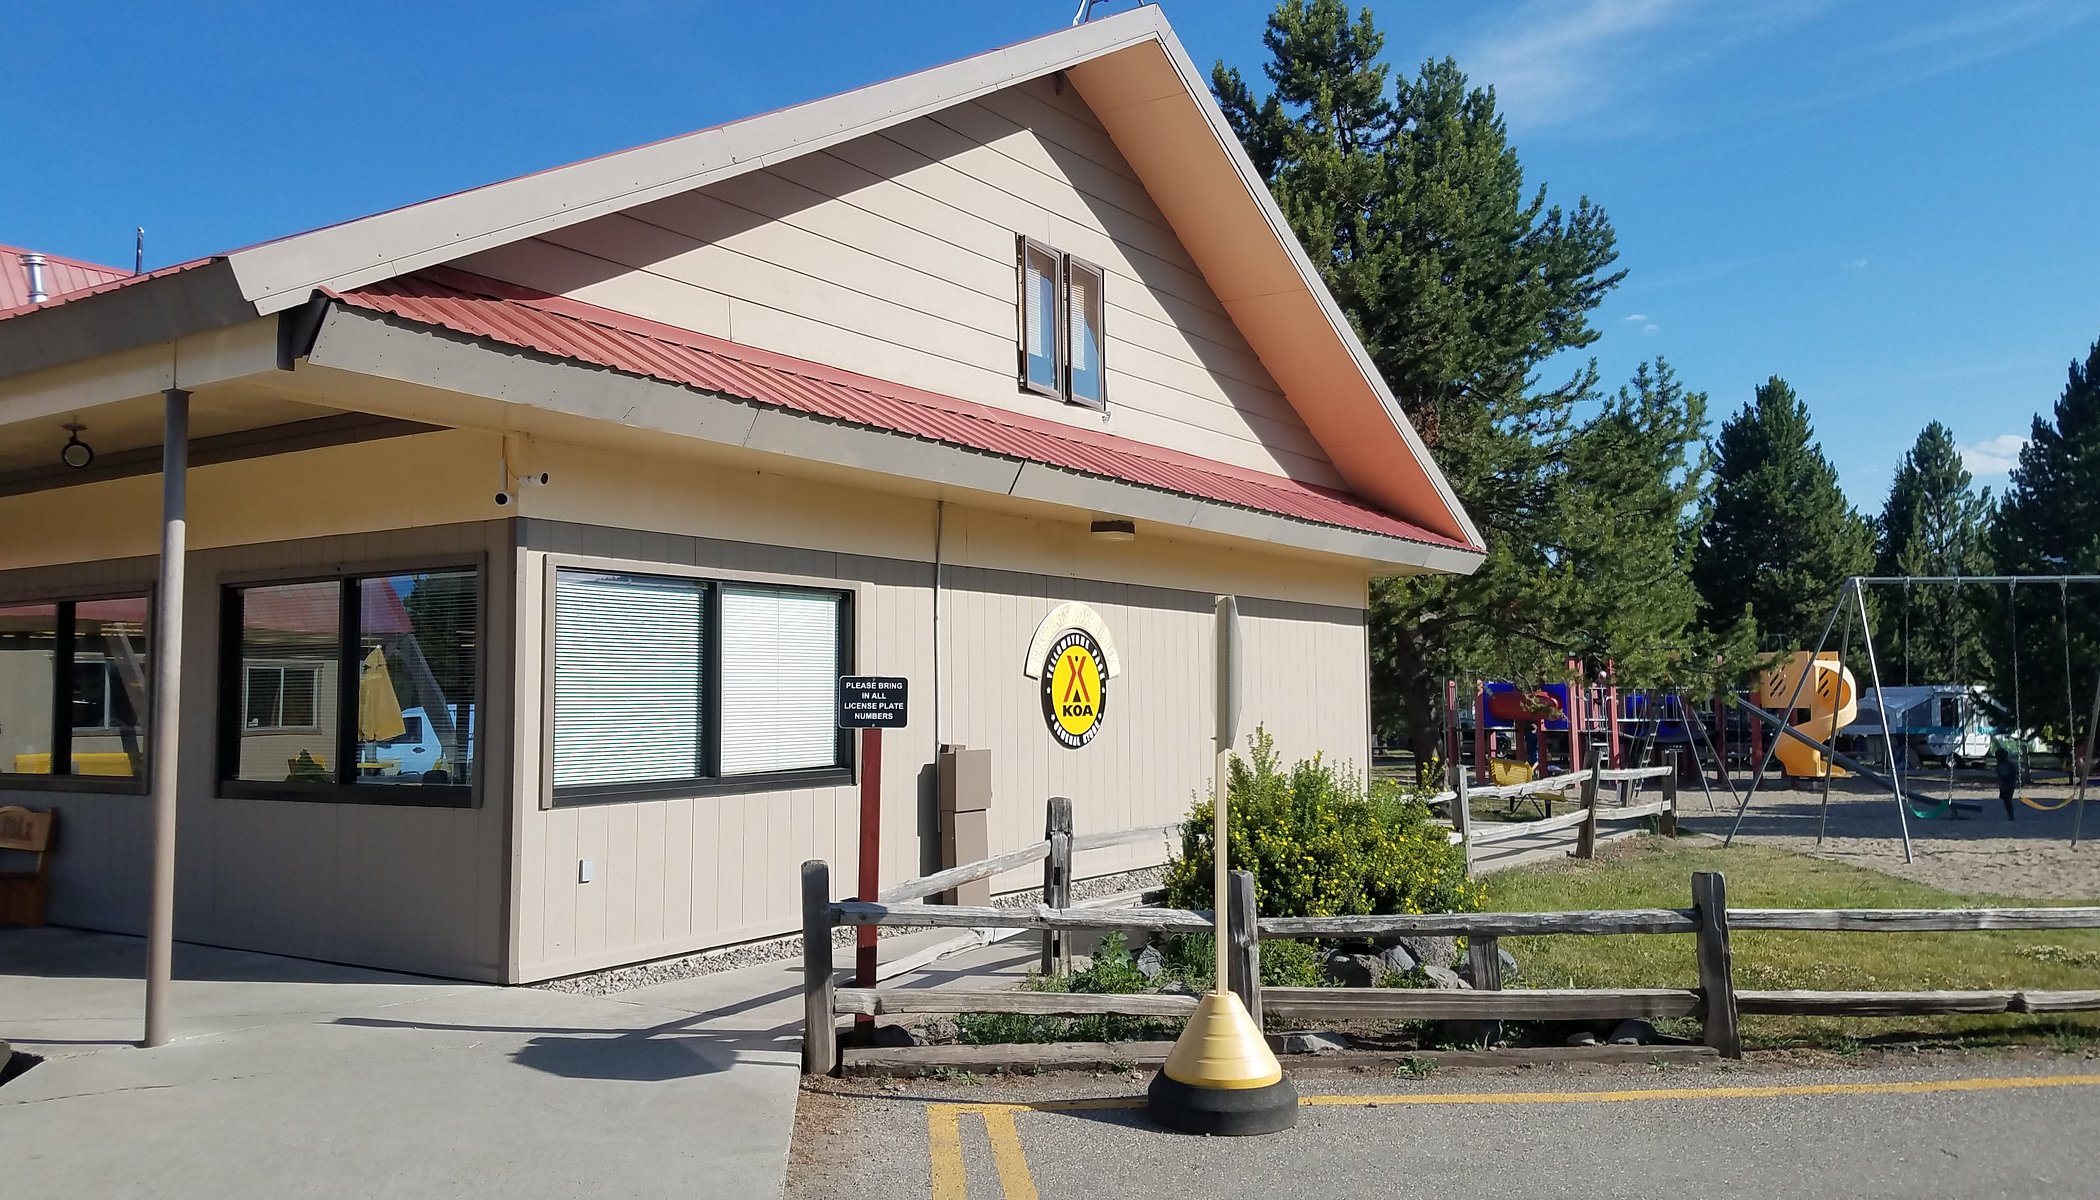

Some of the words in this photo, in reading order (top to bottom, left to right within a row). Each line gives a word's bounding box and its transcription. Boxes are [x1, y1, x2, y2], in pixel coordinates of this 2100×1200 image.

[1046, 634, 1090, 679] YELLOWSTONE
[1091, 649, 1106, 680] PARK
[878, 682, 903, 690] BRING
[871, 692, 887, 700] ALL
[844, 702, 877, 710] LICENSE
[878, 702, 904, 710] PLATE
[1062, 705, 1093, 717] KOA
[854, 712, 894, 720] NUMBERS
[1053, 723, 1081, 747] GENERAL
